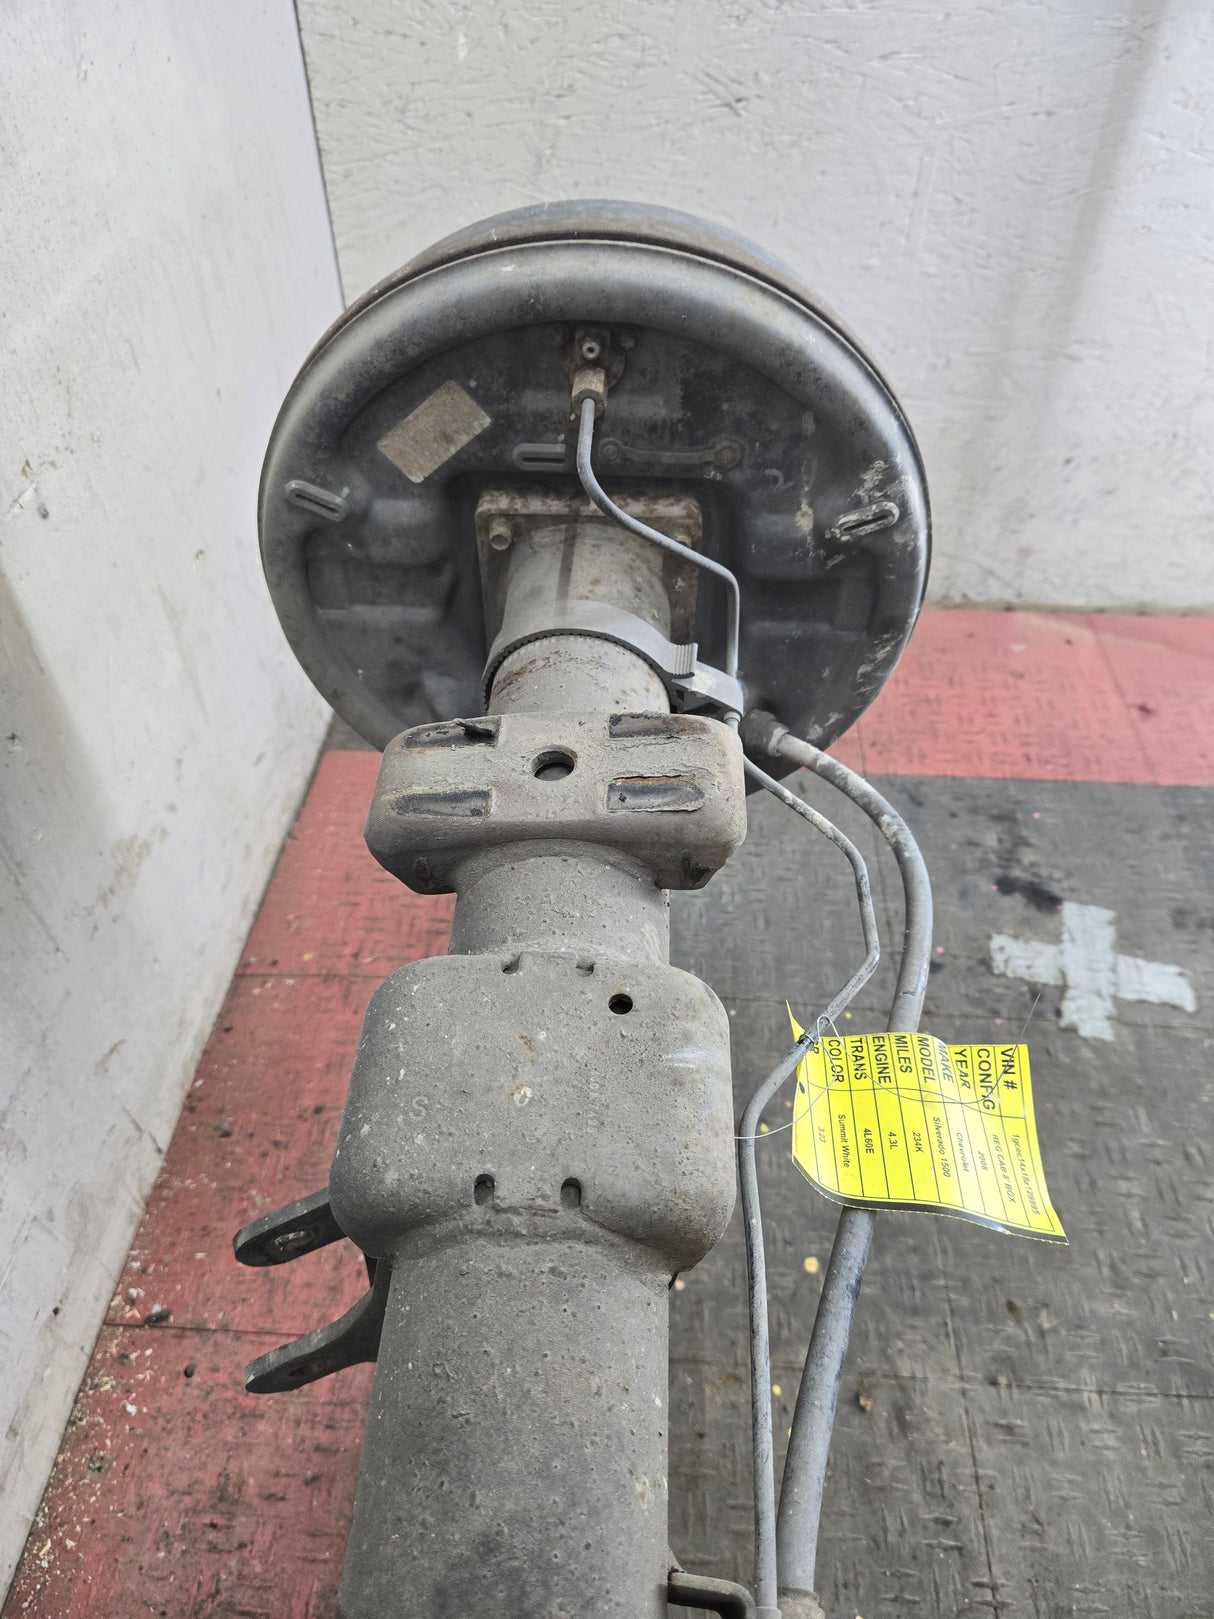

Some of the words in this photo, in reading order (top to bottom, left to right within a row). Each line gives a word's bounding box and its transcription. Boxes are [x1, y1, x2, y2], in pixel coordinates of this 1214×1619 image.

[828, 1039, 845, 1083] COLOR
[850, 1037, 867, 1080] TRANS
[872, 1036, 892, 1084] ENGINE
[894, 1035, 913, 1074] MILES
[917, 1036, 936, 1084] MODEL
[937, 1041, 954, 1083] MAKE
[954, 1048, 971, 1089] YEAR
[1001, 1047, 1016, 1075] VIN
[977, 1048, 996, 1110] CONFIG
[1003, 1080, 1018, 1090] #
[838, 1114, 849, 1143] Summit
[863, 1128, 875, 1154] 4L60E
[888, 1131, 898, 1150] 4.3L
[912, 1131, 924, 1153] 234K
[933, 1116, 945, 1155] Silverado
[940, 1158, 951, 1178] 1500
[841, 1145, 851, 1168] White
[956, 1132, 969, 1172] Chevrolet
[978, 1150, 988, 1171] 2008
[992, 1133, 1002, 1152] REG
[998, 1154, 1008, 1173] CAB
[1004, 1182, 1016, 1203] BOX
